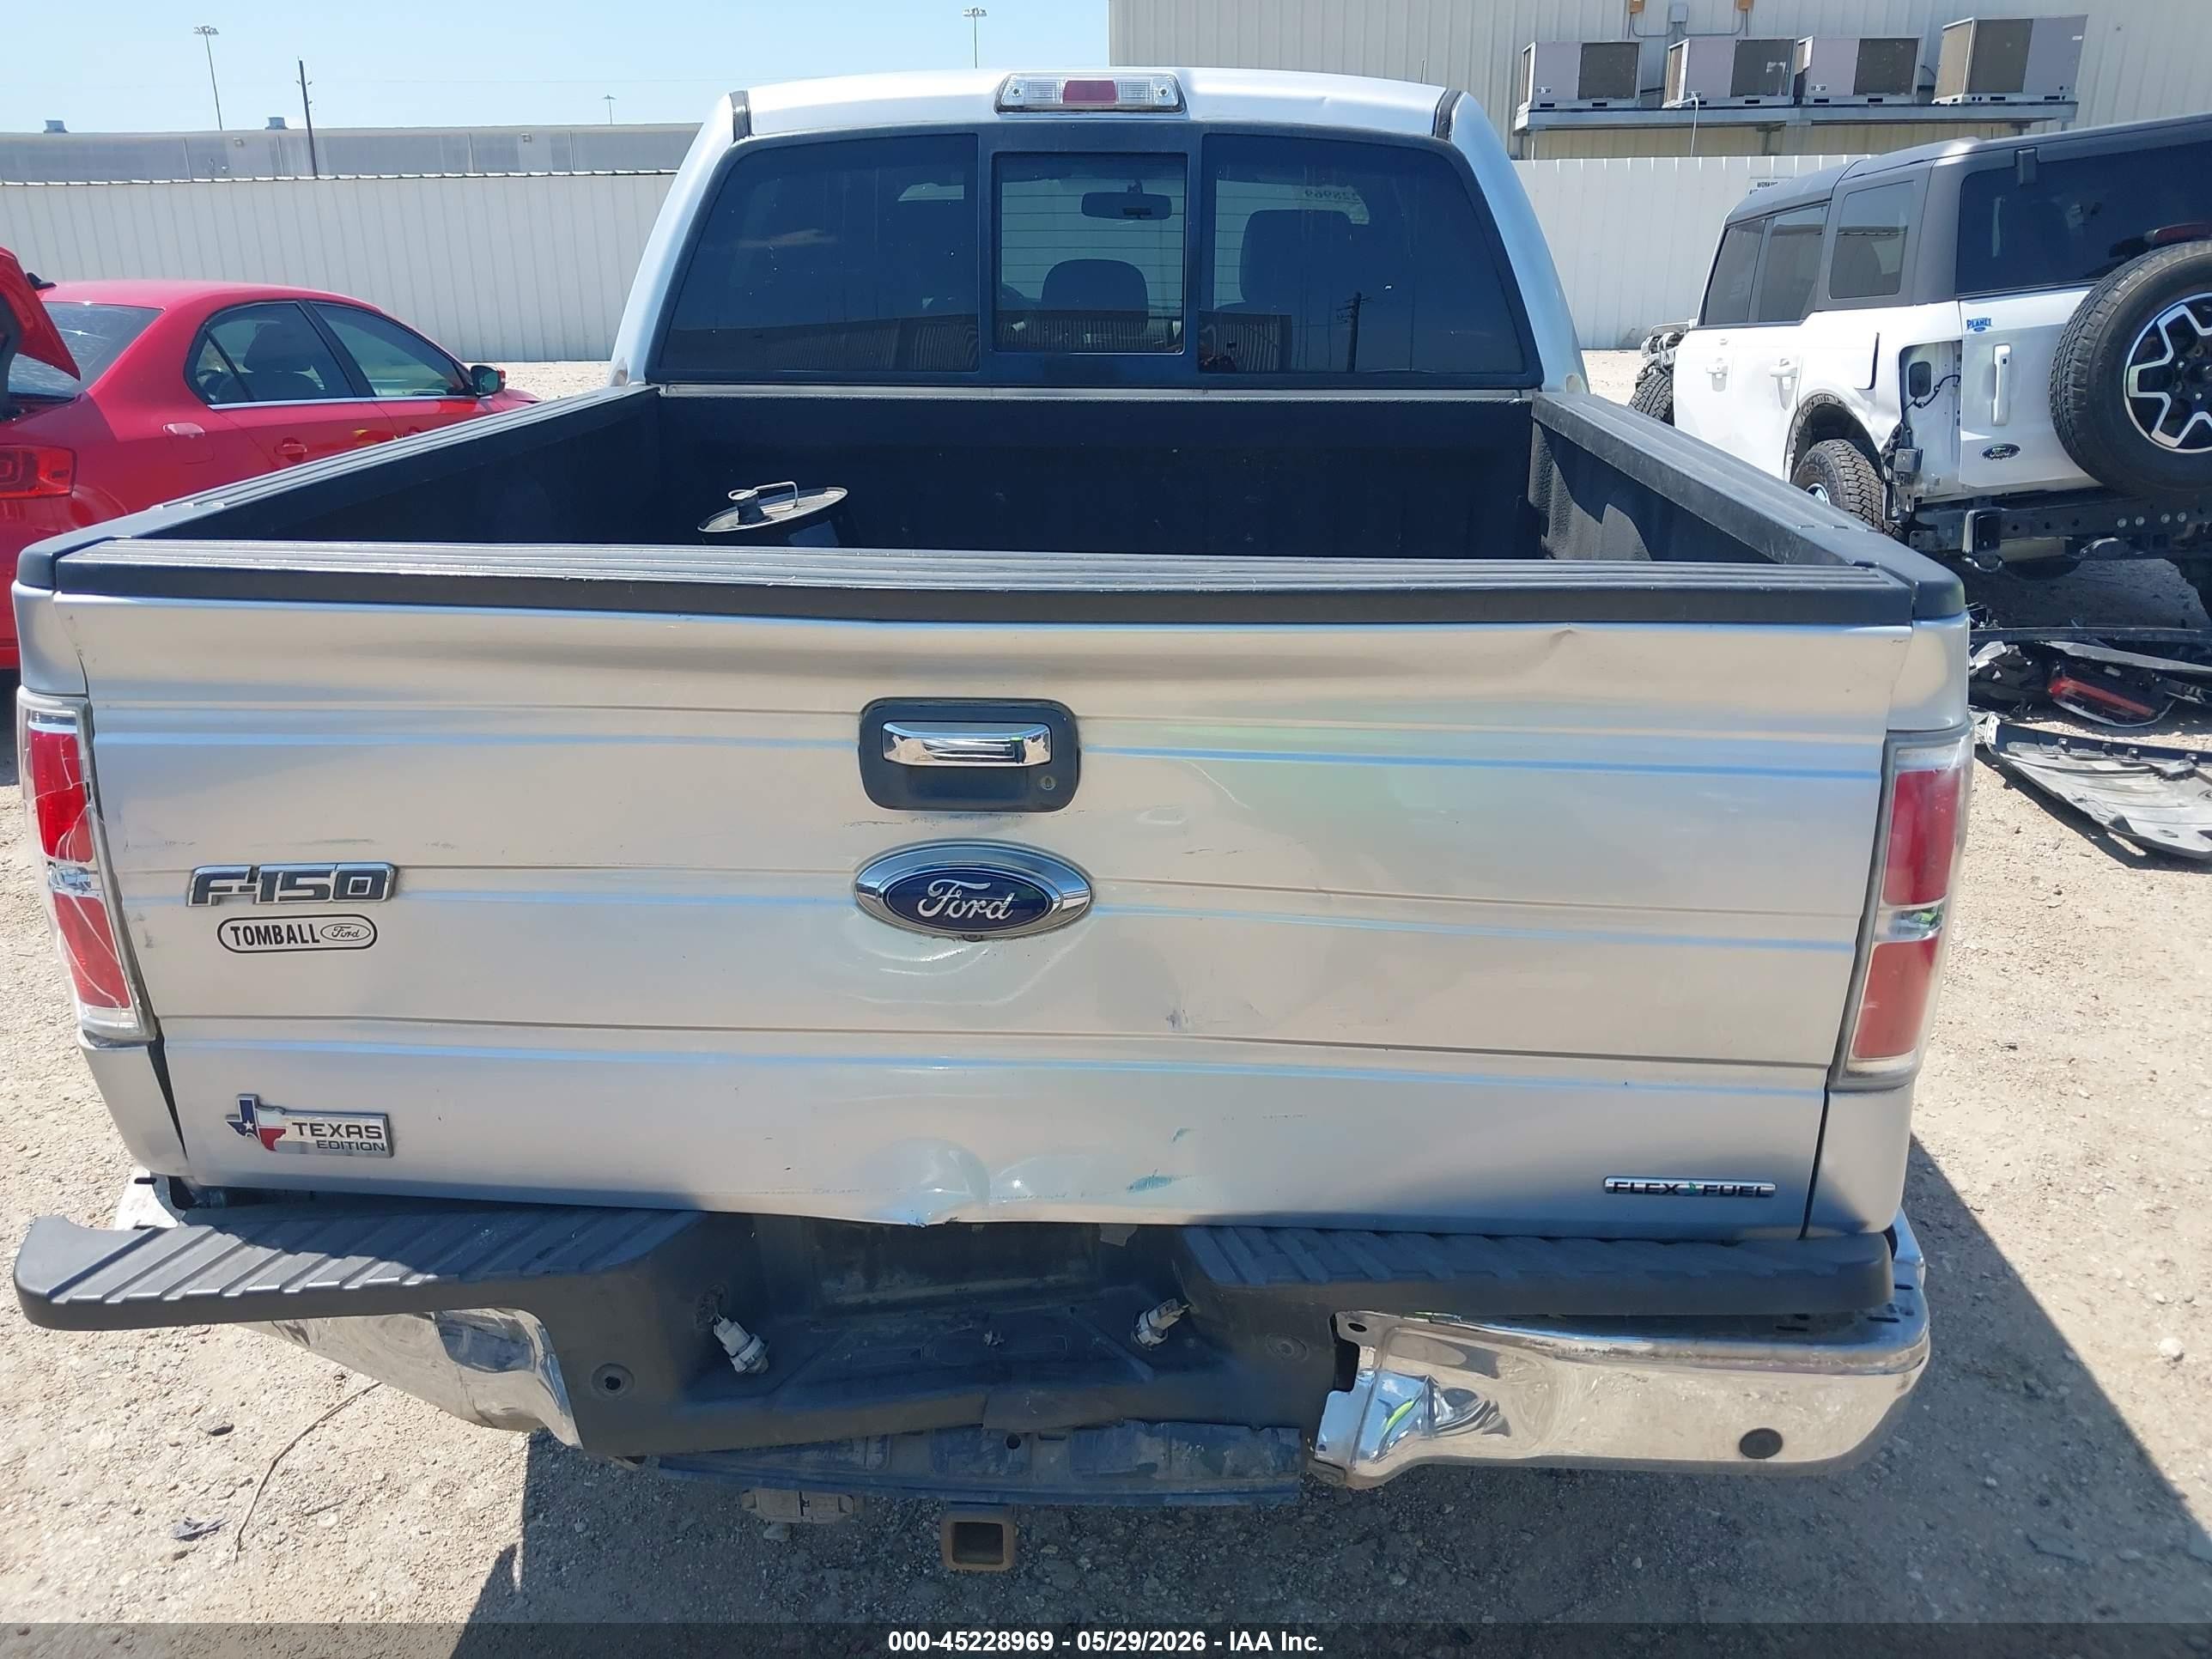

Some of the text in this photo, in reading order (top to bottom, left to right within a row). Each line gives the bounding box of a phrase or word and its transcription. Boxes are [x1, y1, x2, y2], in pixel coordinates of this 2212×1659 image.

[187, 861, 398, 907] F-150
[917, 878, 1015, 920] Ford
[230, 923, 361, 946] TOMBALL Ford
[292, 1121, 383, 1139] TEXAS
[316, 1139, 386, 1152] EDITION
[1613, 1181, 1772, 1197] FLEX FUEL
